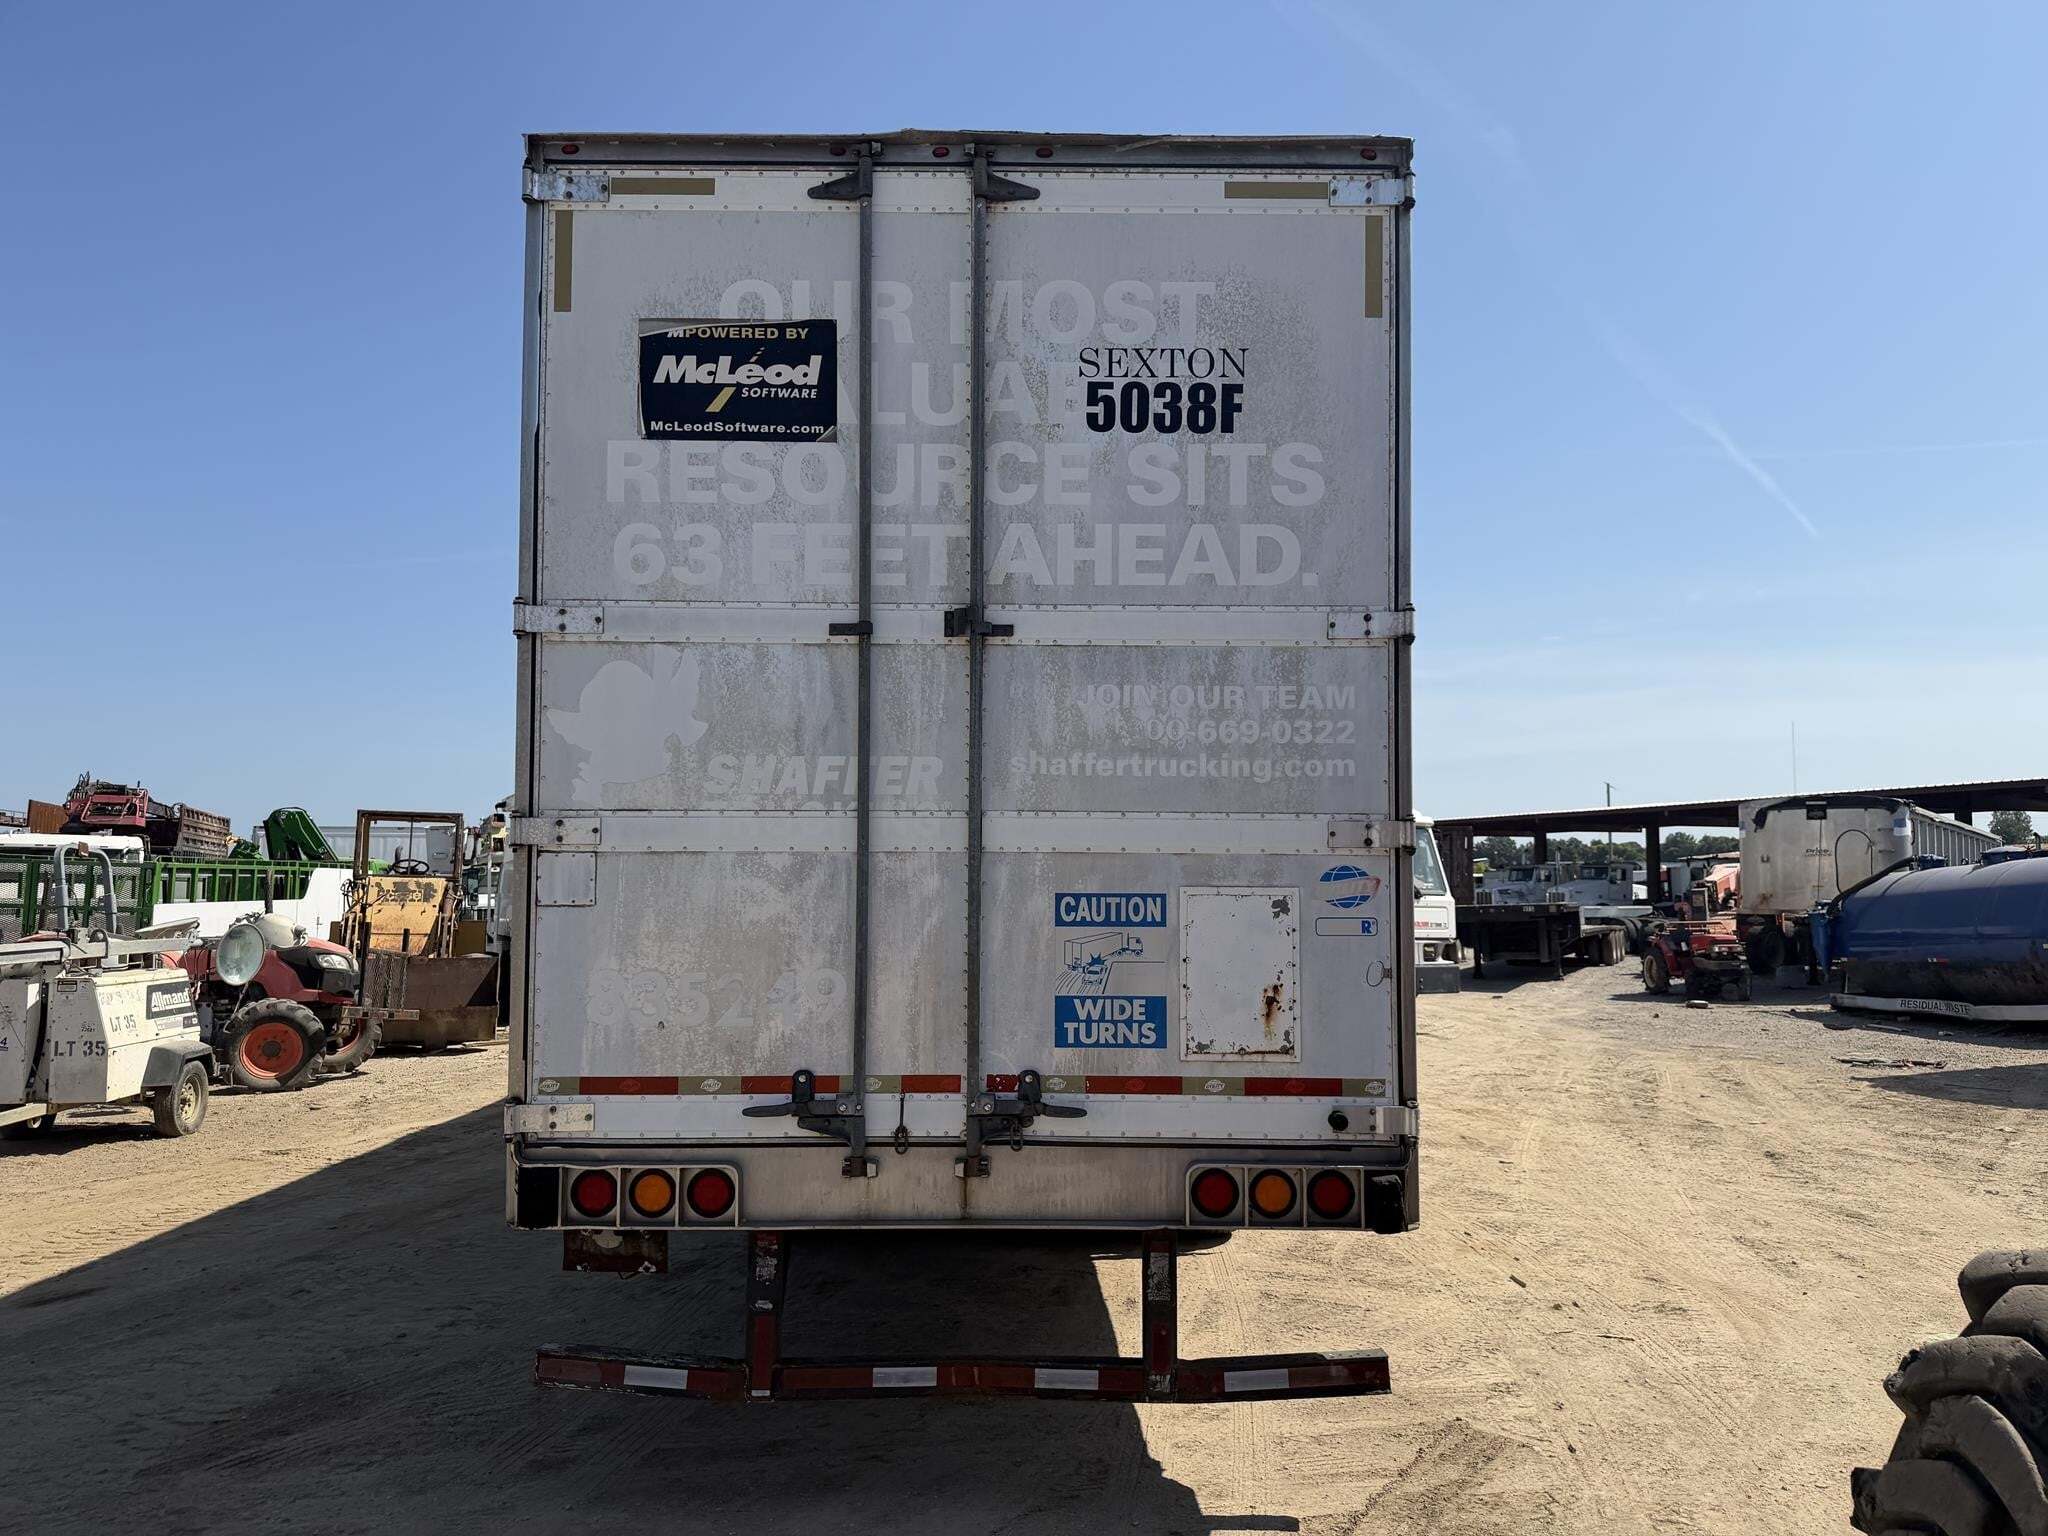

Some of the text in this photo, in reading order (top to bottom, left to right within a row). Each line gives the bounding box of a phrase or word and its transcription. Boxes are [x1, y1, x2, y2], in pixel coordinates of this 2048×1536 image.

[950, 280, 1217, 346] MOST
[785, 328, 809, 340] BY
[1079, 347, 1249, 378] SEXTON
[741, 387, 818, 399] SOFTWARE
[1086, 381, 1244, 434] 5038F
[650, 421, 824, 434] McLeodSoftware.com
[607, 440, 1326, 507] RESOURCE SITS
[614, 522, 1319, 587] 63 FEET AHEAD.
[1078, 684, 1356, 710] JOIN OUR TEAM
[1128, 719, 1356, 745] 00-669-0322
[1009, 752, 1356, 783] shaffertrucking.com
[1060, 897, 1162, 922] CAUTION
[151, 988, 190, 1009] Allmand
[1073, 999, 1146, 1021] WIDE
[1900, 999, 1944, 1011] RESIDUAL
[110, 1016, 122, 1032] LT
[124, 1014, 137, 1029] 35
[1063, 1022, 1157, 1045] TURNS
[54, 1040, 106, 1057] LT 35
